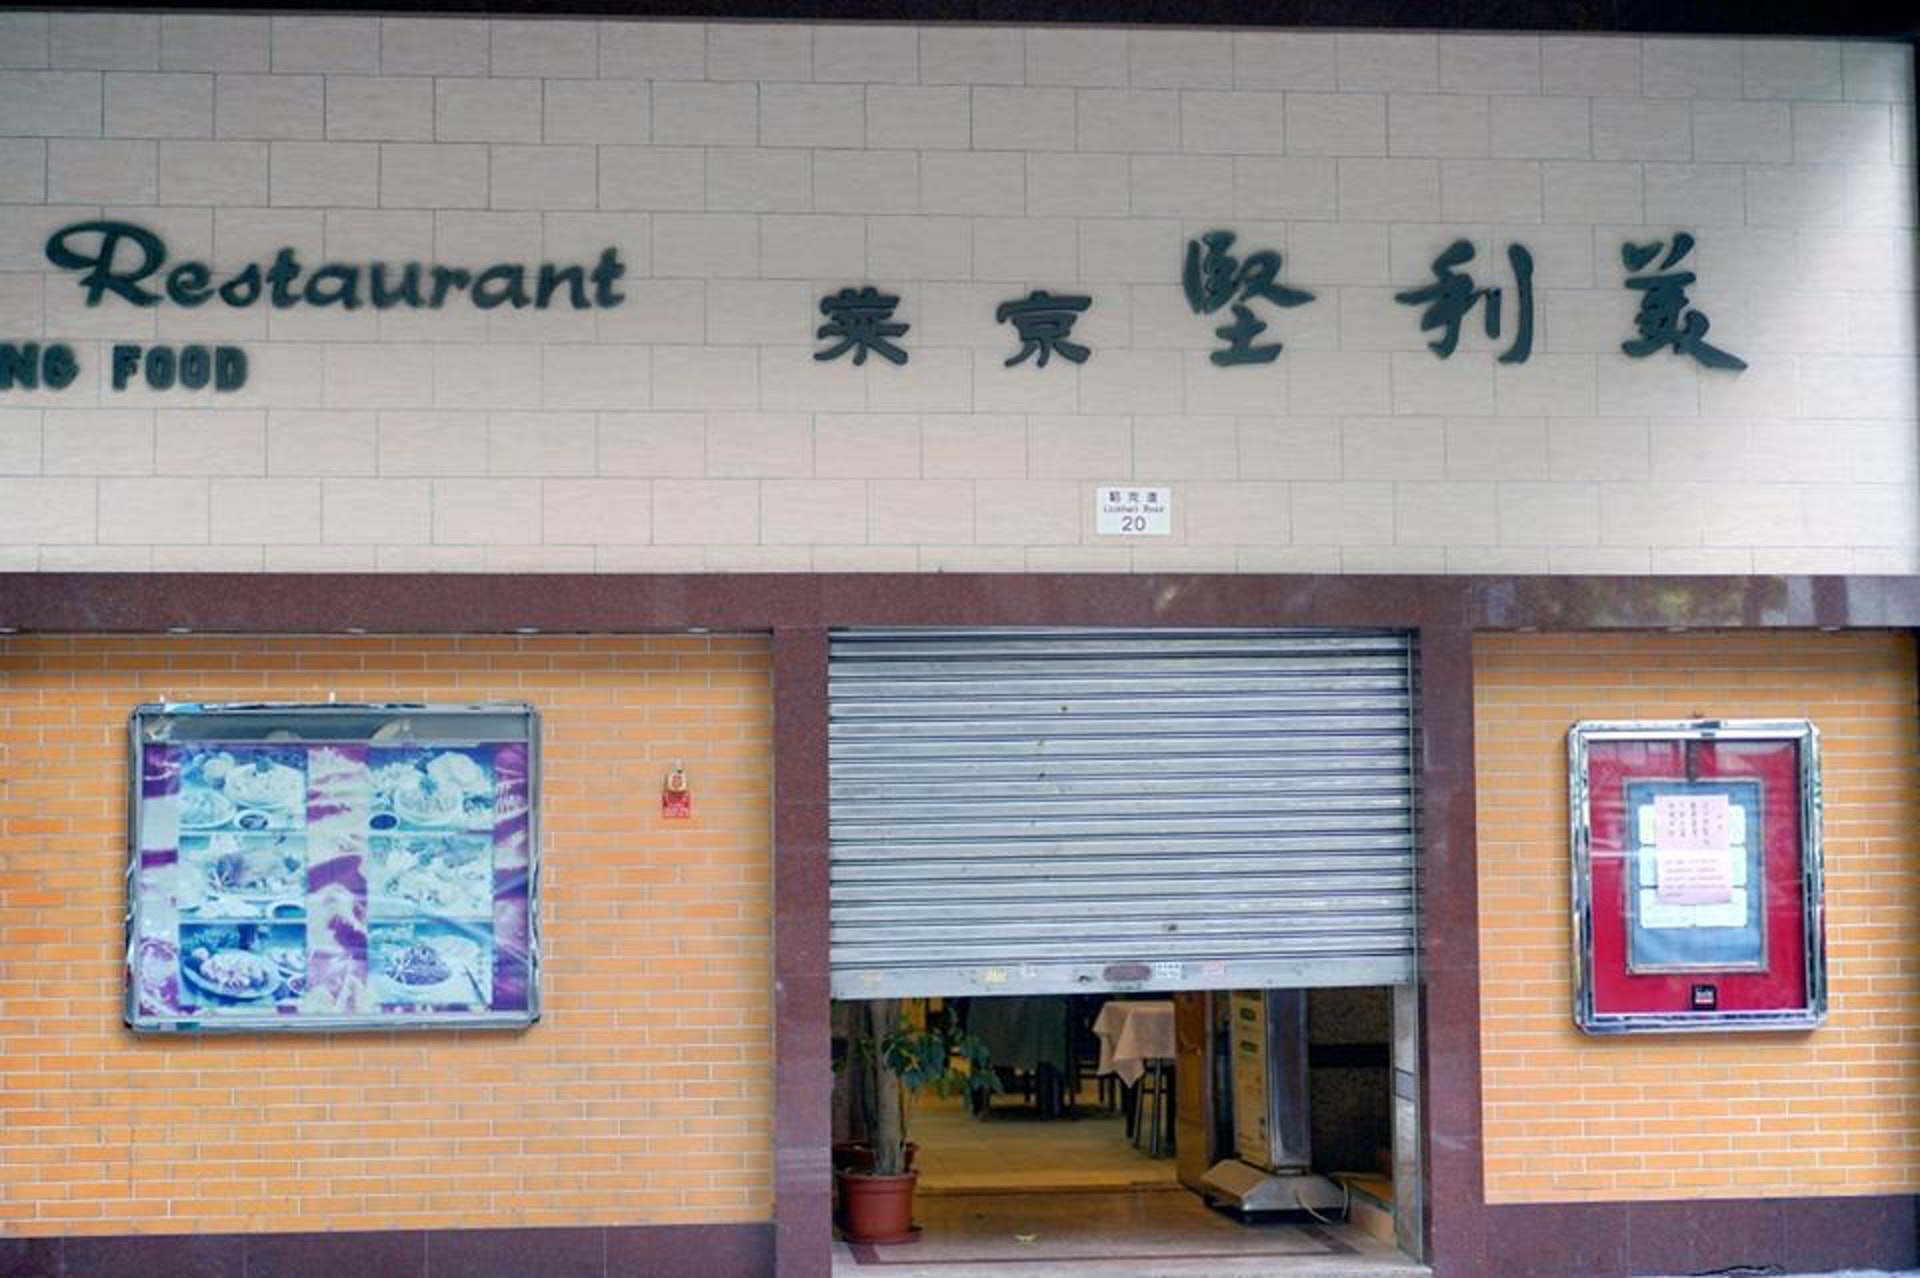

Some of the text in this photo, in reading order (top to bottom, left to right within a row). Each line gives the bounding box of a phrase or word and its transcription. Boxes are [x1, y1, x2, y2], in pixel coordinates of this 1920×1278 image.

[44, 218, 626, 311] Restaurant
[112, 344, 247, 392] FOOD
[1121, 515, 1147, 531] 20
